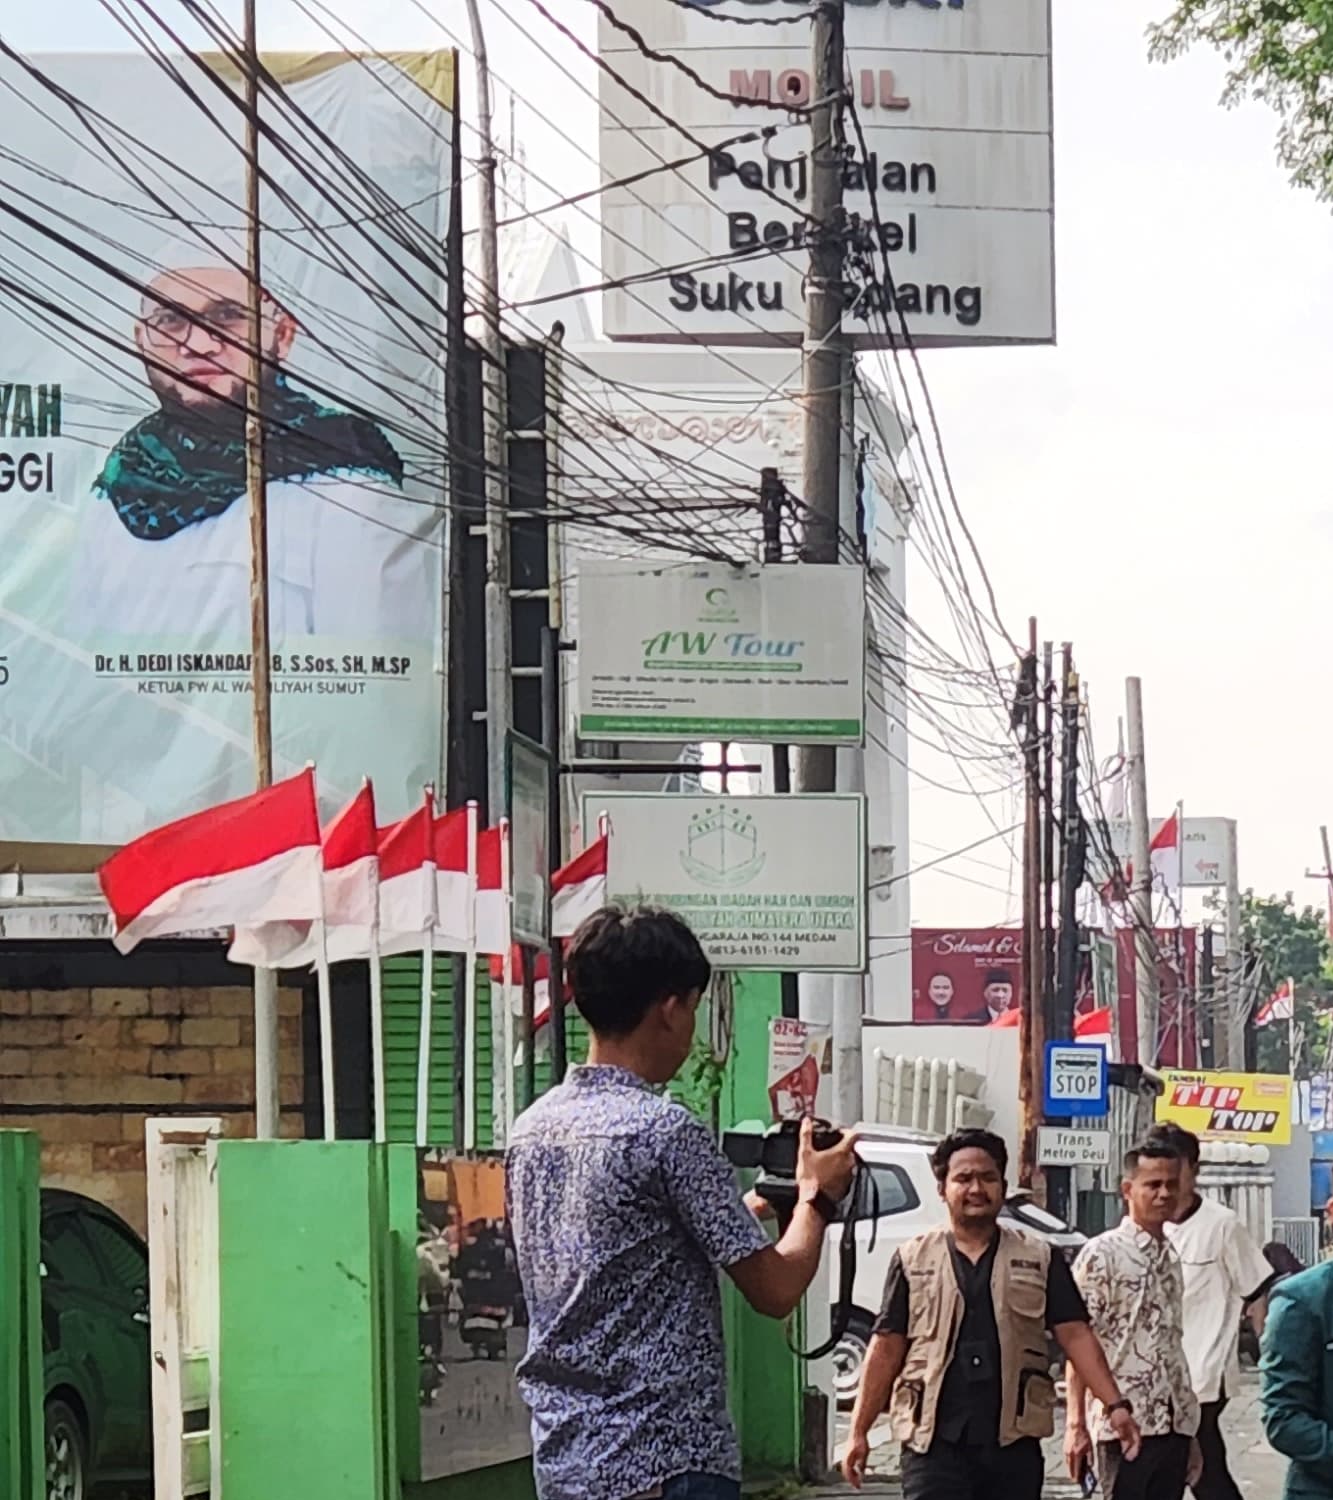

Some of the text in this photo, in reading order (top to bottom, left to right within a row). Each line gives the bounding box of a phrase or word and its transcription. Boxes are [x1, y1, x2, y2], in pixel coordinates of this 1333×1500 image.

[729, 68, 910, 111] MOIL
[708, 150, 937, 199] Penjalan
[669, 272, 784, 312] Suku
[641, 631, 805, 657] AW Tour
[95, 655, 115, 672] Dr.
[119, 655, 134, 672] H.
[138, 655, 173, 672] DEDI
[138, 681, 185, 694] KETUA
[212, 681, 228, 693] AL
[317, 682, 366, 695] SUMUT
[794, 933, 837, 943] MEDAN
[1056, 1074, 1098, 1094] STOP
[1175, 1085, 1241, 1108] TIP
[1212, 1109, 1276, 1131] TOP
[1056, 1132, 1093, 1146] Trans
[1043, 1148, 1105, 1161] Metro Deli
